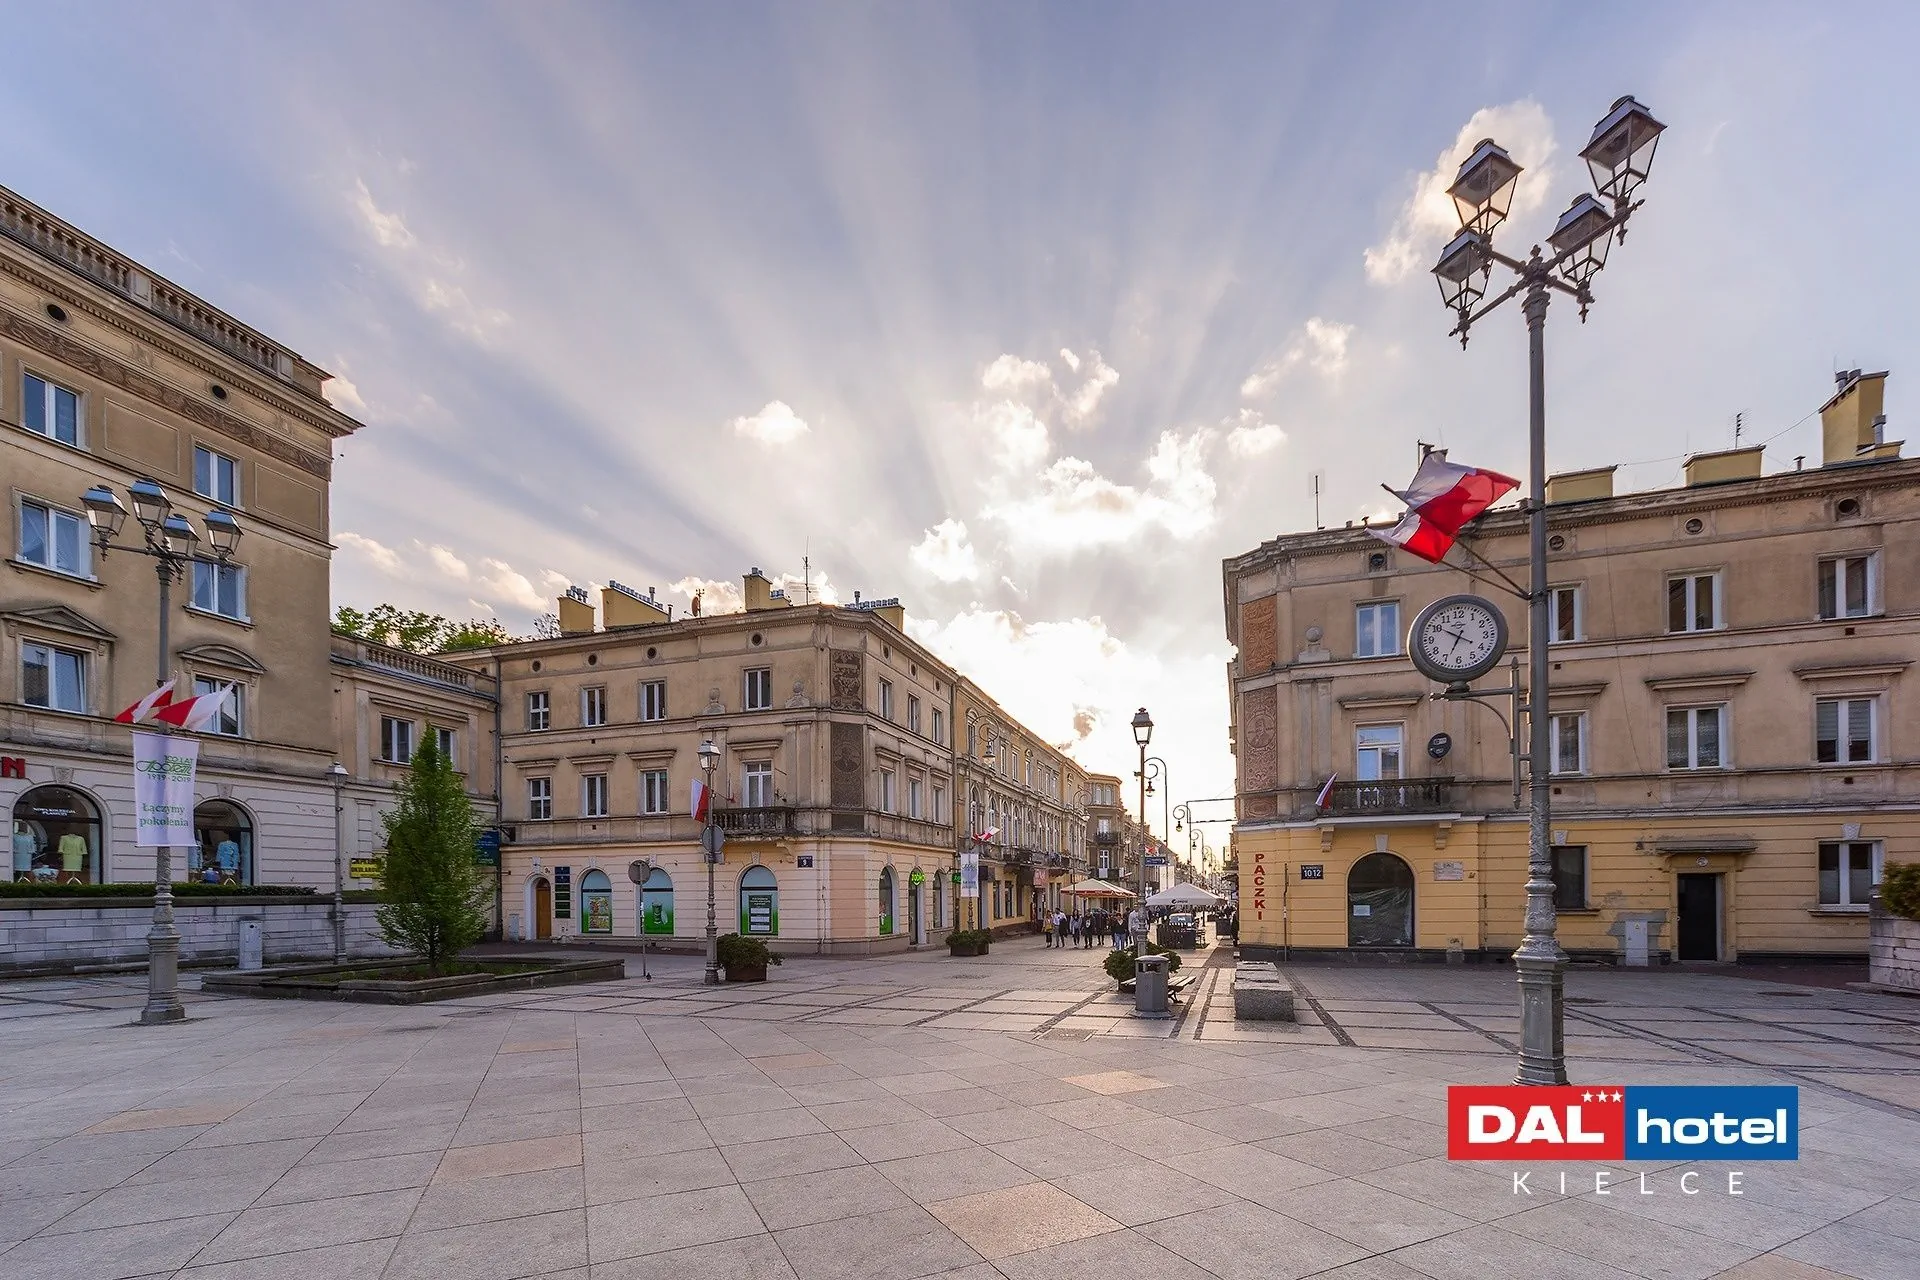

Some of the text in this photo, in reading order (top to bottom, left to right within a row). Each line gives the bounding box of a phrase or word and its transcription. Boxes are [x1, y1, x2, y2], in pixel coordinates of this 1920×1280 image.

[1441, 615, 1450, 623] 11
[1453, 610, 1465, 619] 12
[1470, 613, 1475, 621] 1
[1432, 624, 1442, 633] 10
[1478, 620, 1485, 629] 2
[1483, 631, 1489, 639] 3
[1428, 636, 1435, 645] 9
[1432, 646, 1439, 655] 8
[1478, 643, 1485, 651] 4
[1442, 654, 1449, 662] 7
[1455, 656, 1462, 664] 6
[1469, 651, 1476, 660] 5
[180, 756, 194, 764] LAT
[2, 756, 26, 779] N
[147, 773, 167, 781] 1919
[172, 775, 192, 783] 2019
[142, 802, 186, 816] Łączymy
[139, 816, 189, 828] pokolenia
